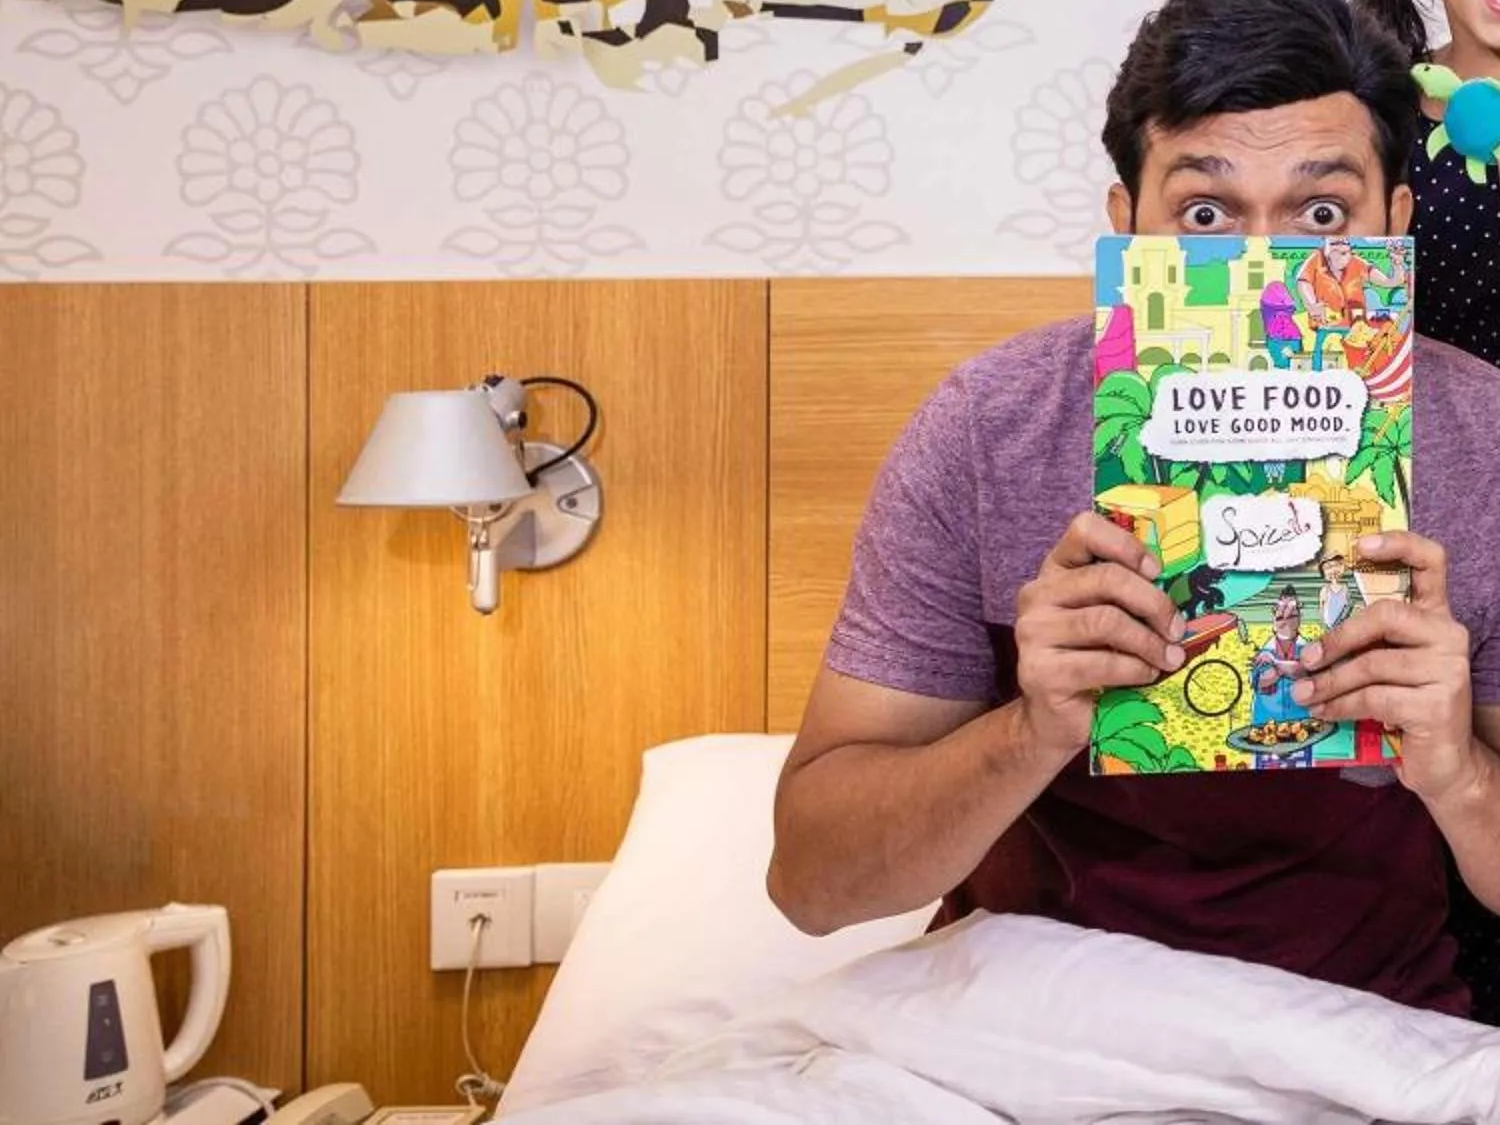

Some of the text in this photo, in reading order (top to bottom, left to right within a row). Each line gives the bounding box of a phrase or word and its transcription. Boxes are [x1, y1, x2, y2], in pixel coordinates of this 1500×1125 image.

[1172, 385, 1352, 411] LOVE FOOD.
[1174, 416, 1350, 434] LOVE GOOD MOOD.
